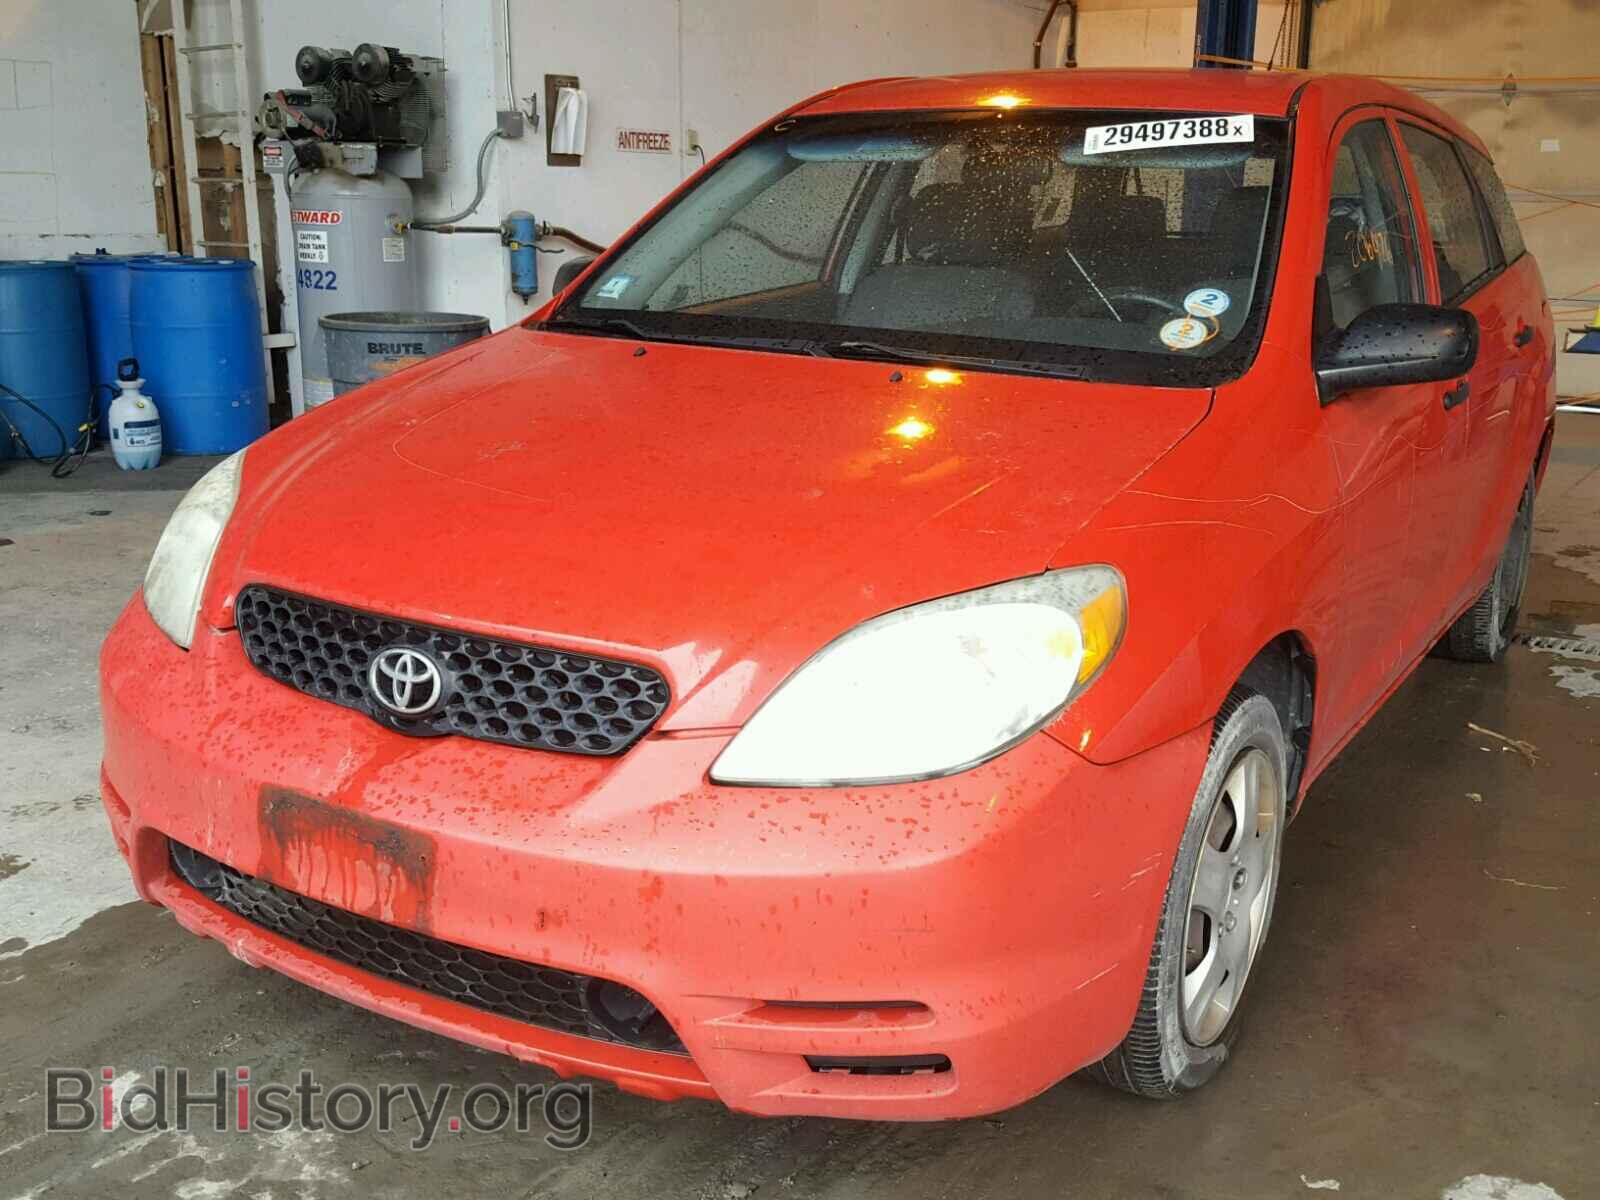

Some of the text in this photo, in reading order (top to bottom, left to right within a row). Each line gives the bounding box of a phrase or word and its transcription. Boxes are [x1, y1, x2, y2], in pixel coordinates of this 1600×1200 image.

[618, 131, 670, 150] ANTIFREEZE
[1103, 118, 1229, 146] 29497388
[297, 268, 337, 290] 4822
[1199, 293, 1219, 306] 2
[367, 342, 426, 354] BRUTE
